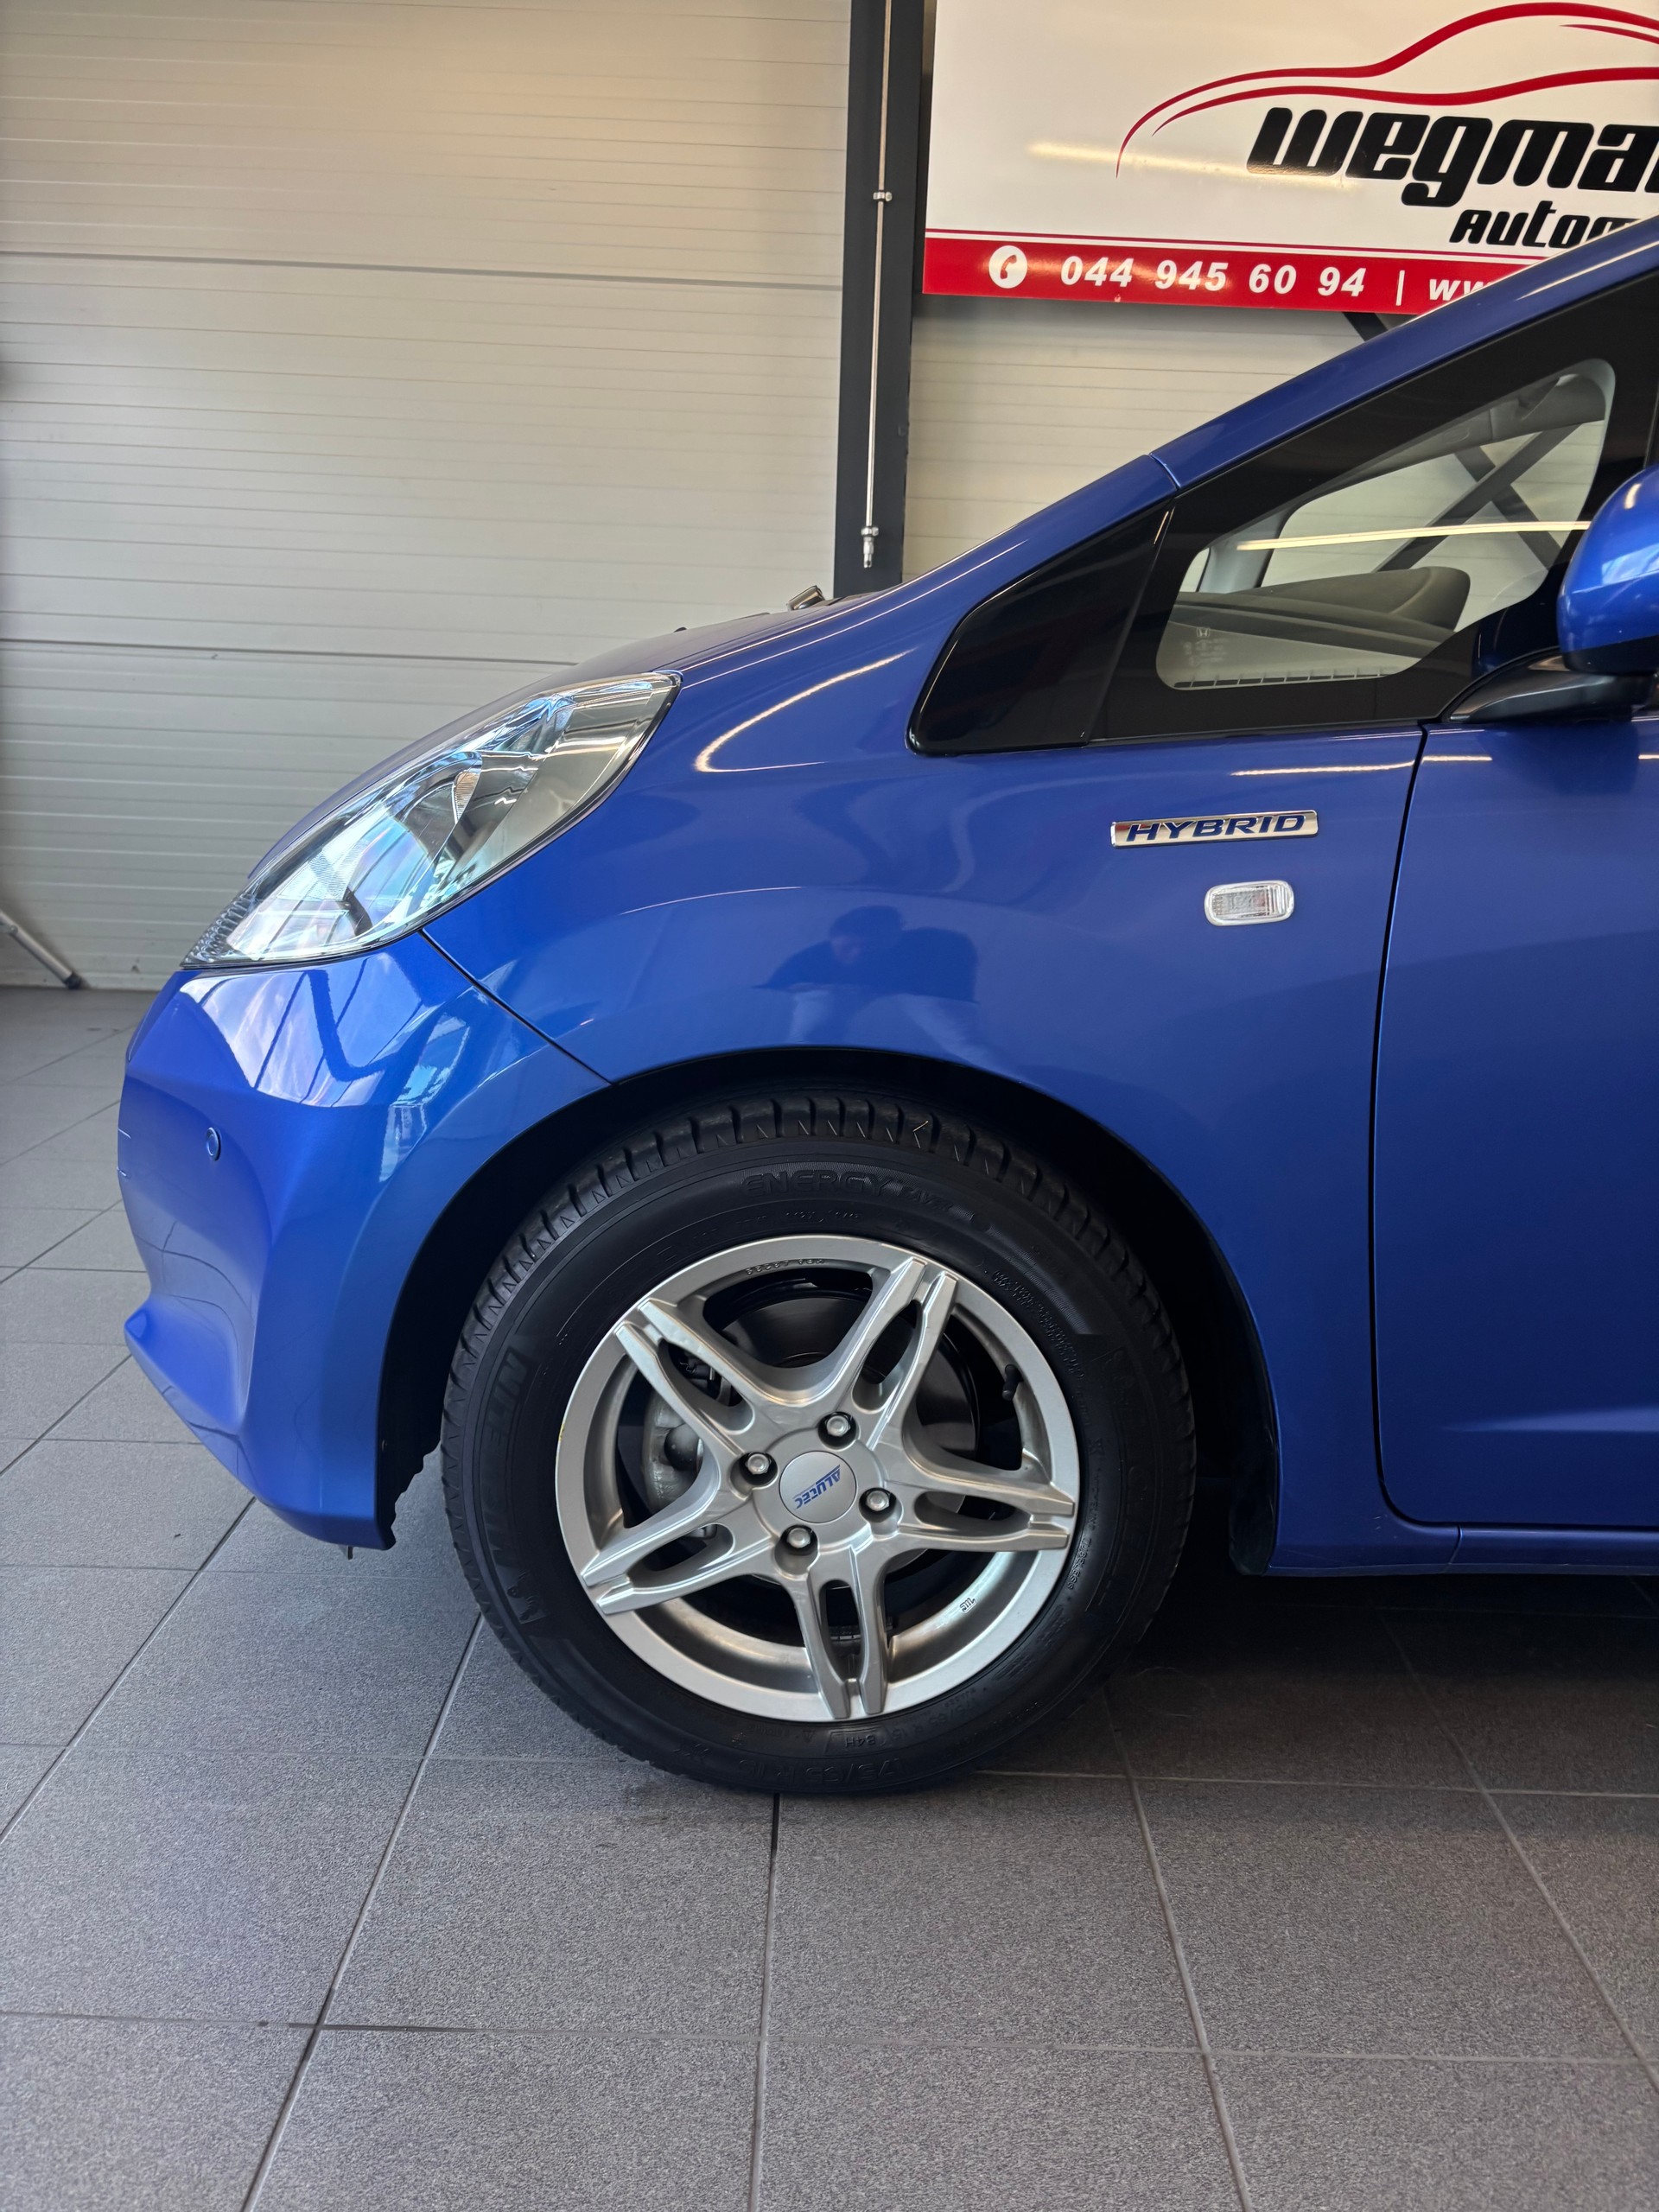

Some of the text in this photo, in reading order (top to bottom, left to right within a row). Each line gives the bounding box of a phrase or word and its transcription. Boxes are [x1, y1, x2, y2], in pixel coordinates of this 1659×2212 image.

[1246, 106, 1659, 208] wegma
[1060, 255, 1134, 288] 044
[1154, 259, 1228, 293] 945
[1248, 264, 1297, 295] 60
[1317, 266, 1366, 297] 94
[1126, 815, 1306, 842] HYBRID
[742, 1169, 893, 1198] ENERGY
[793, 1467, 842, 1510] ALUTEC
